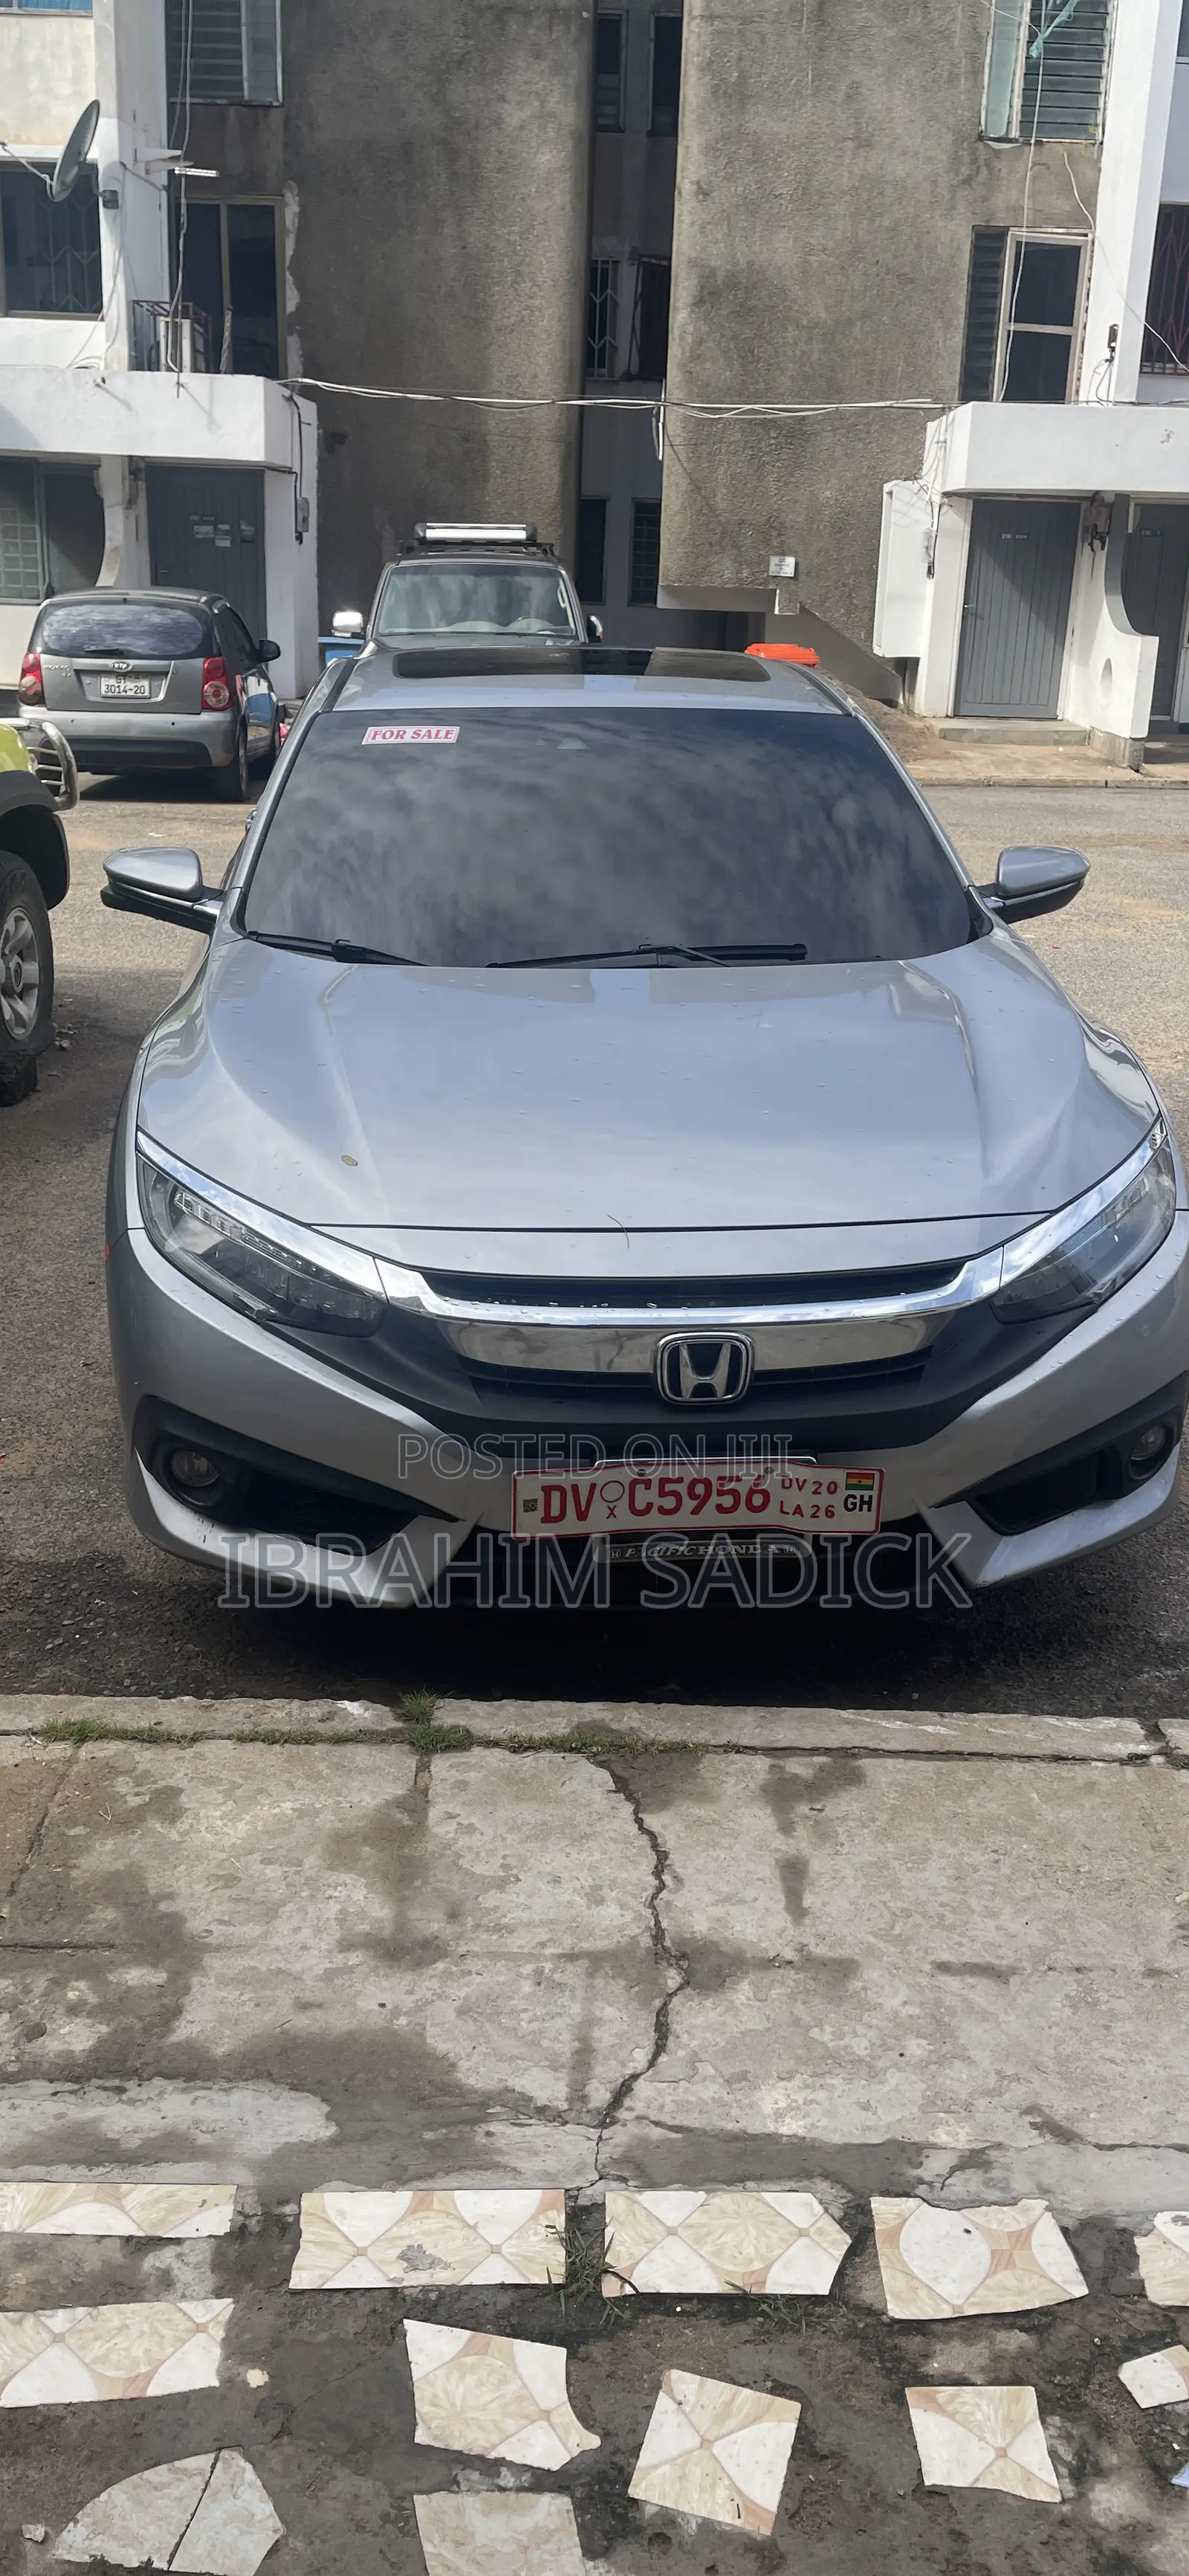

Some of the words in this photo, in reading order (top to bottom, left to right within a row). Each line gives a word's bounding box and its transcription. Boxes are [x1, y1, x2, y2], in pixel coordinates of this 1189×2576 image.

[104, 684, 146, 694] 3014-20
[371, 729, 407, 740] FOR
[410, 729, 455, 740] SALE
[540, 1482, 597, 1524] DV
[843, 1494, 874, 1512] GH
